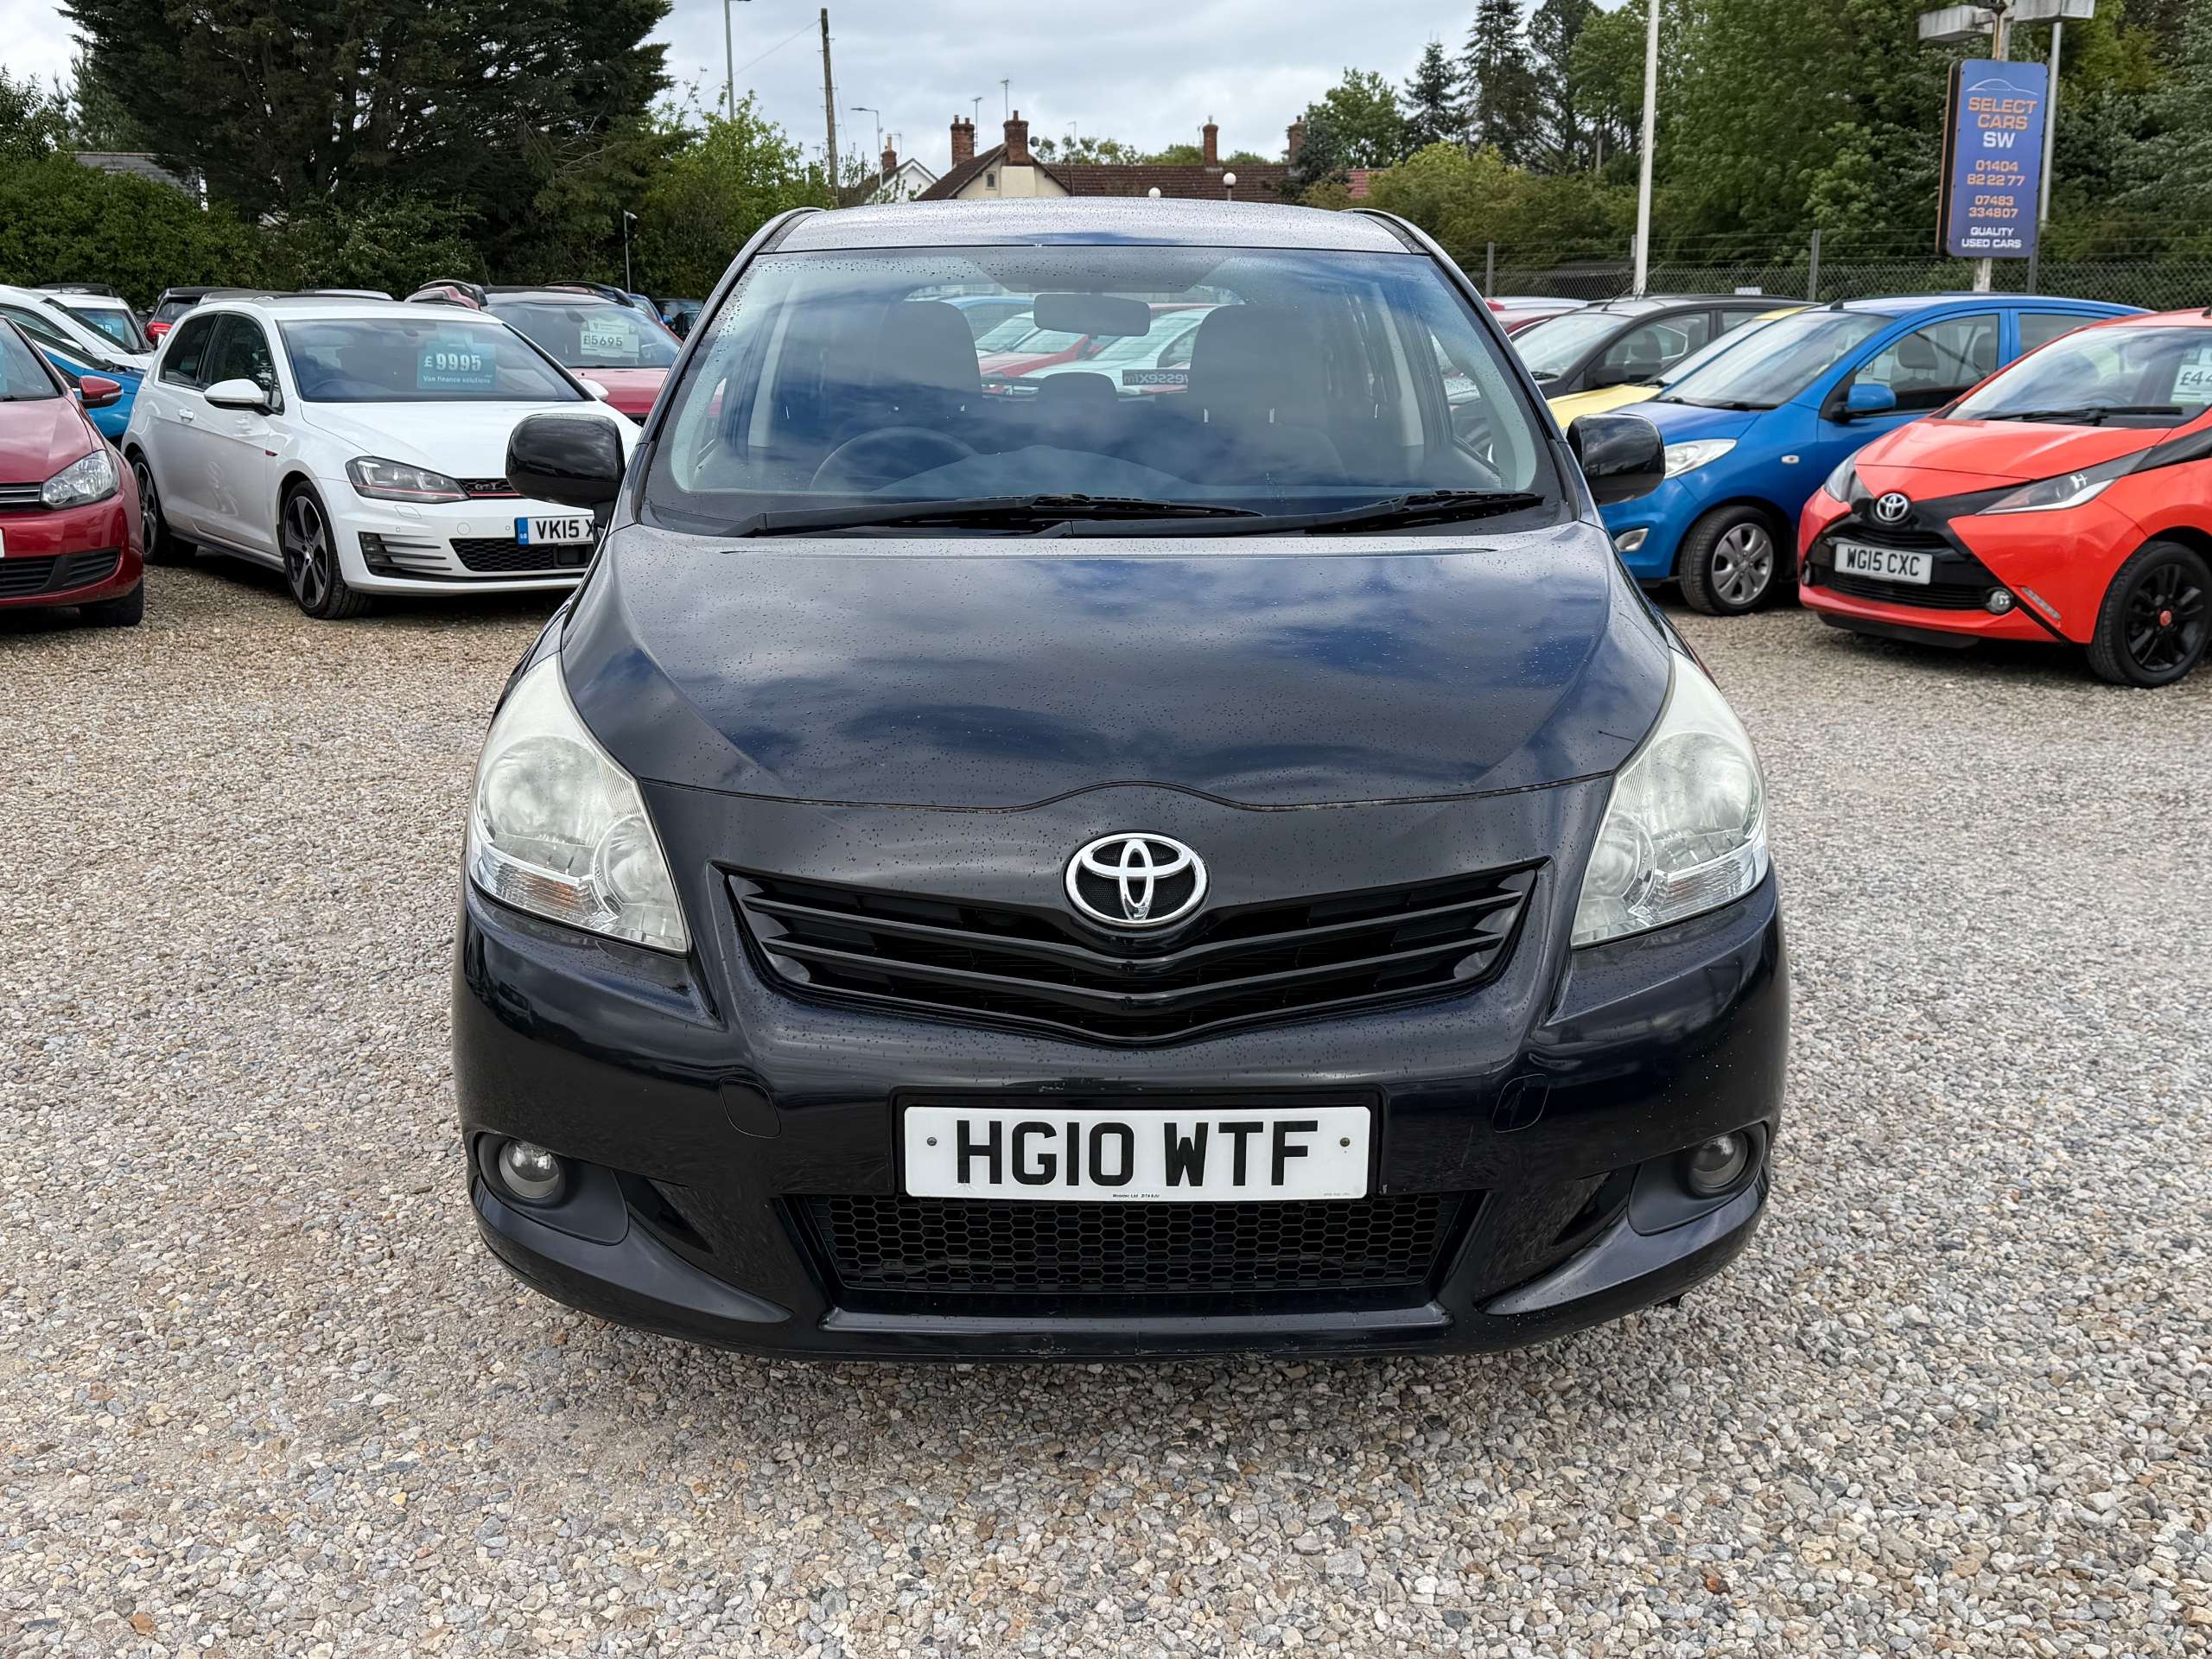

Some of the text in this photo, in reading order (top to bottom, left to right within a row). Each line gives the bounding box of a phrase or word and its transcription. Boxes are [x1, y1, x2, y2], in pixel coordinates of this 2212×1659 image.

[1968, 97, 2037, 114] SELECT
[1978, 114, 2028, 130] CARS
[1983, 131, 2015, 149] SW
[1976, 160, 2018, 172] 01404
[1975, 195, 2014, 206] 07483
[1968, 207, 2018, 218] 334807
[1970, 226, 2014, 236] QUALITY
[1961, 238, 2022, 248] USED CARS
[536, 519, 579, 539] VK15
[1847, 547, 1921, 576] WG15 CXC
[957, 1120, 1319, 1186] HG10 WTF
